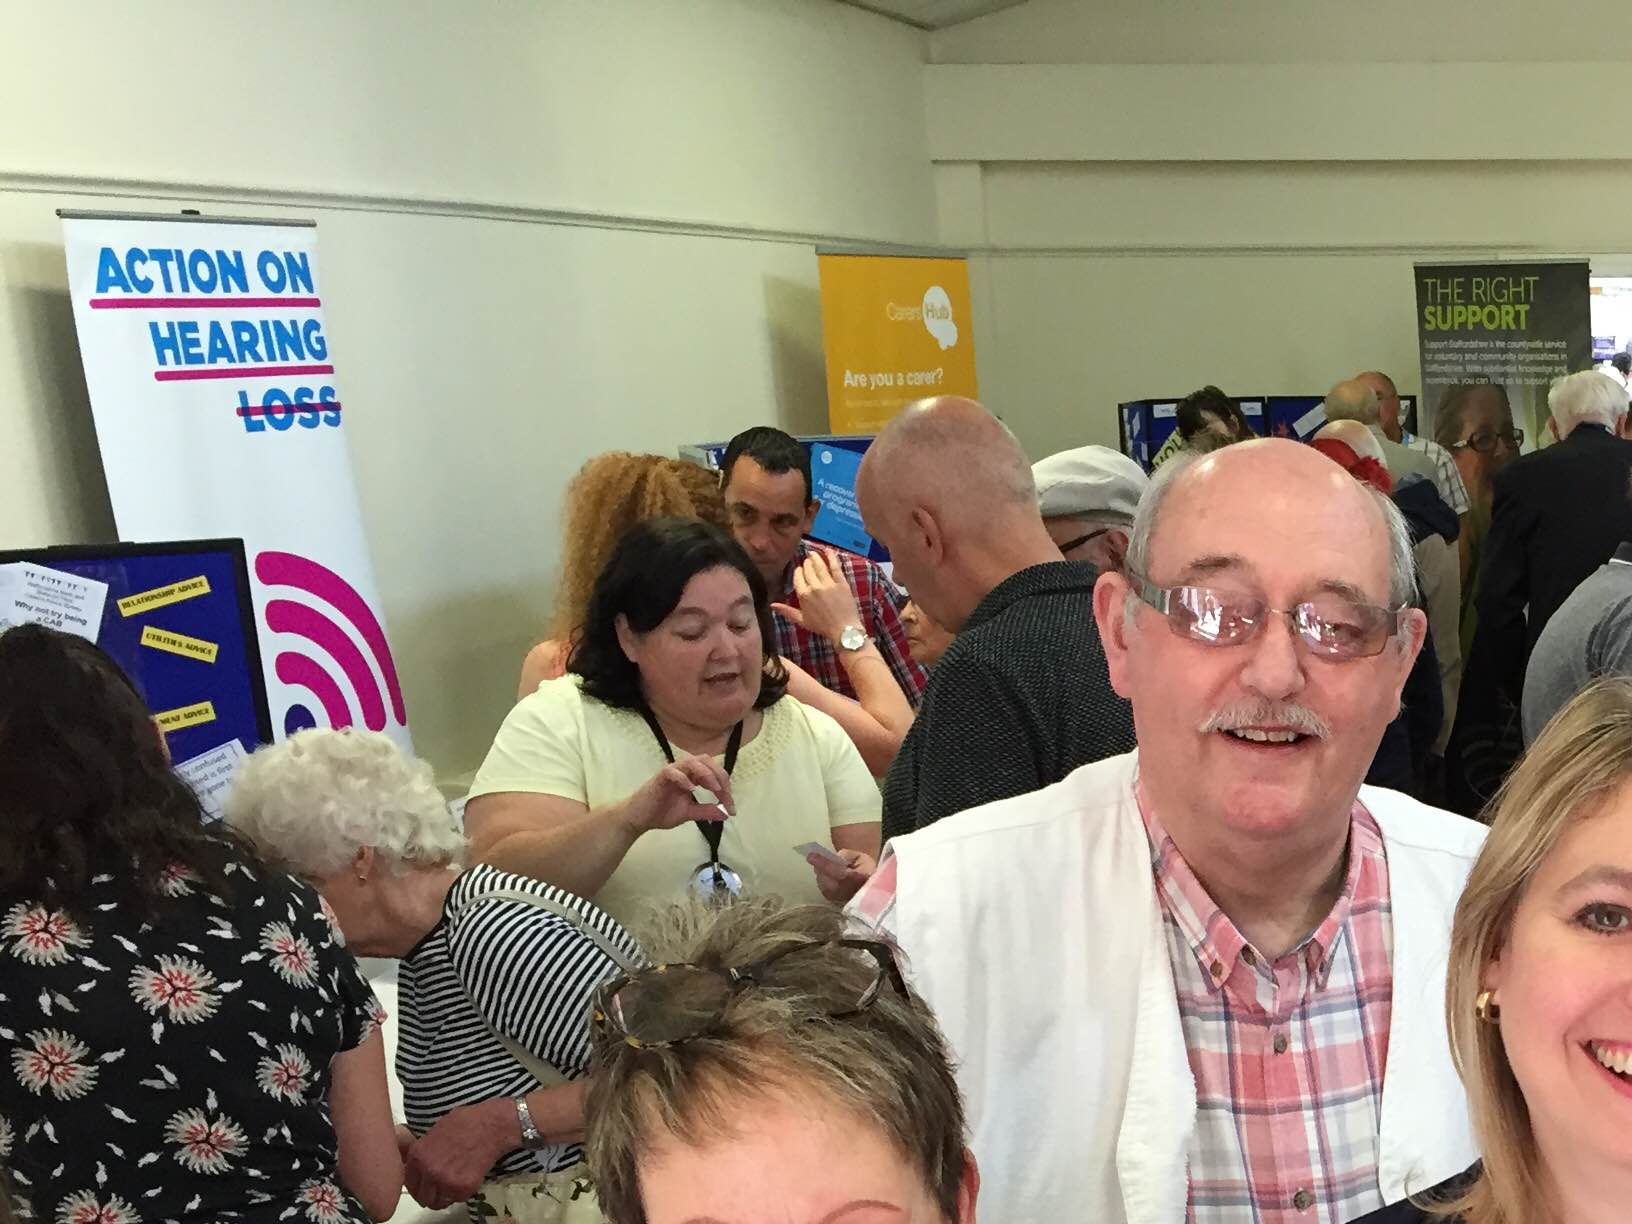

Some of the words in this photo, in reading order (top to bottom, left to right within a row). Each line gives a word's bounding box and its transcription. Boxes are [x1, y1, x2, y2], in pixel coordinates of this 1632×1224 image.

[96, 247, 249, 294] ACTION
[257, 250, 314, 294] ON
[1423, 278, 1464, 303] THE
[1472, 276, 1539, 303] RIGHT
[1424, 304, 1530, 330] SUPPORT
[149, 319, 328, 366] HEARING
[844, 370, 867, 387] Are
[869, 373, 893, 390] you
[897, 373, 905, 385] a
[907, 368, 944, 385] carer?
[238, 386, 341, 432] LOSS
[121, 588, 176, 609] RELATIONSHIP
[177, 580, 205, 593] ADVICE
[15, 599, 33, 611] Why
[51, 610, 62, 619] try
[64, 613, 87, 626] being
[146, 632, 183, 648] UTILITIES
[185, 643, 213, 656] ADVICE
